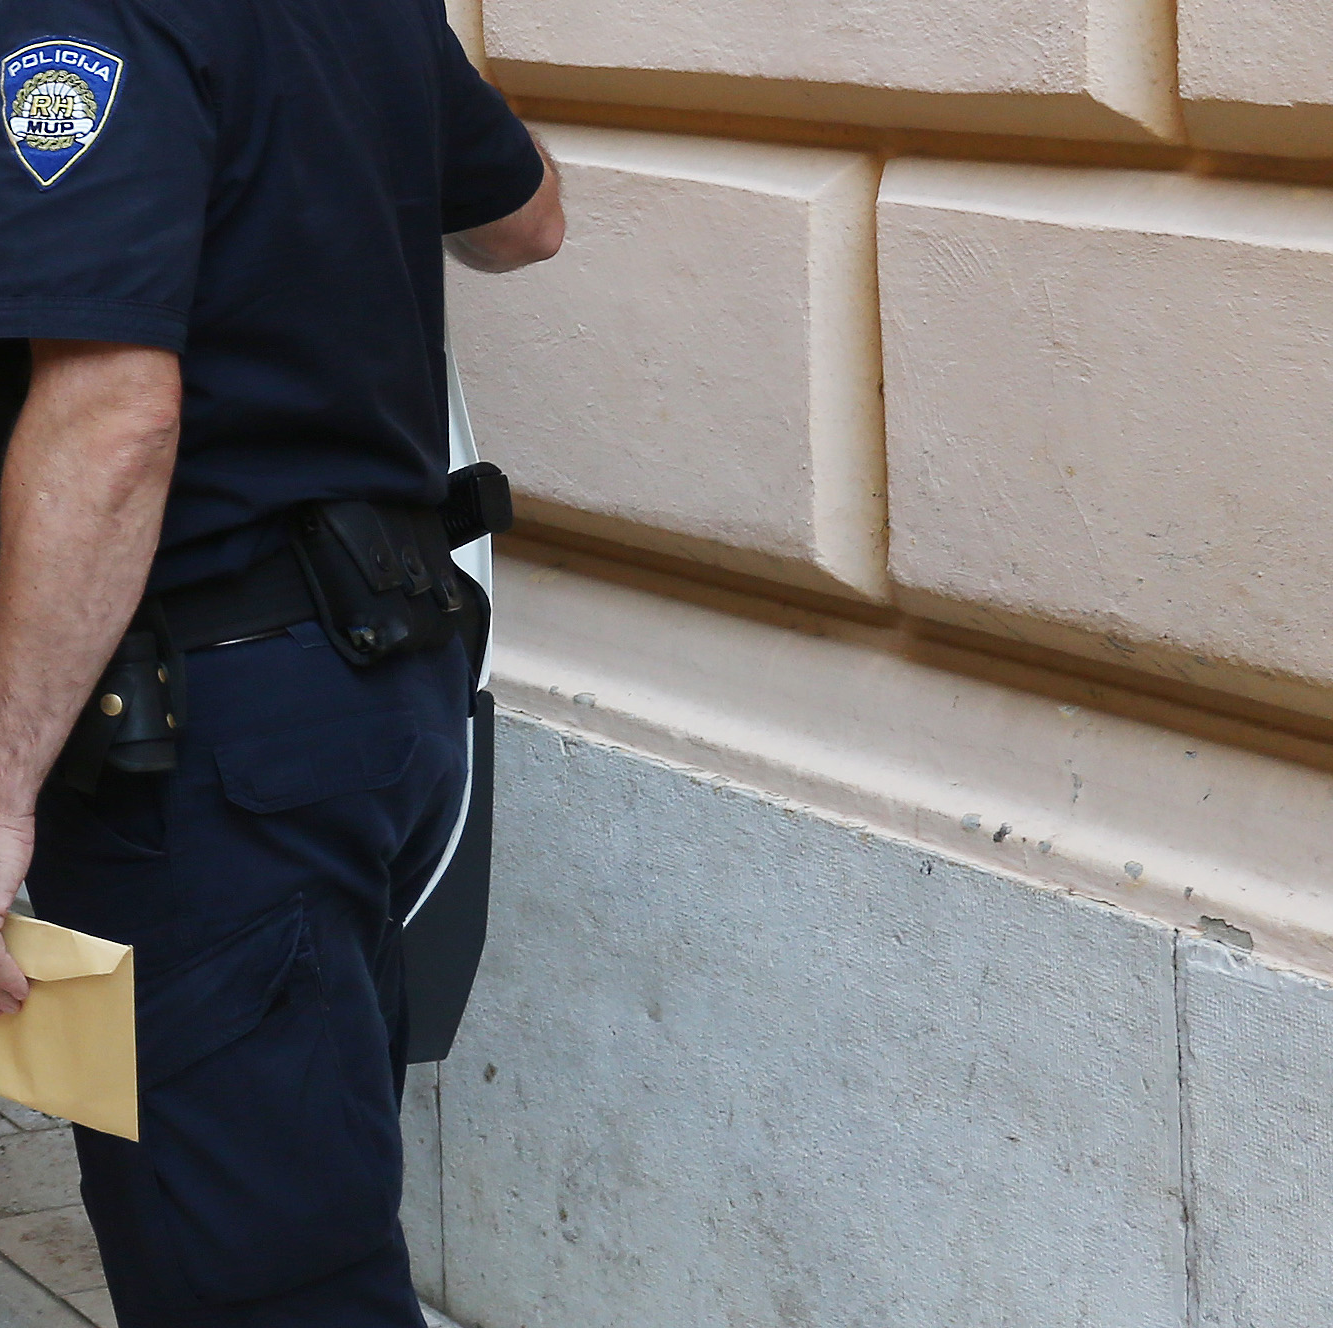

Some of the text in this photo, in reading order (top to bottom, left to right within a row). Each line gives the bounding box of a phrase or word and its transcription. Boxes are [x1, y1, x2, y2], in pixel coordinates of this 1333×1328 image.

[7, 49, 110, 82] POLICIJA
[30, 95, 74, 118] RH
[27, 121, 74, 134] MUP
